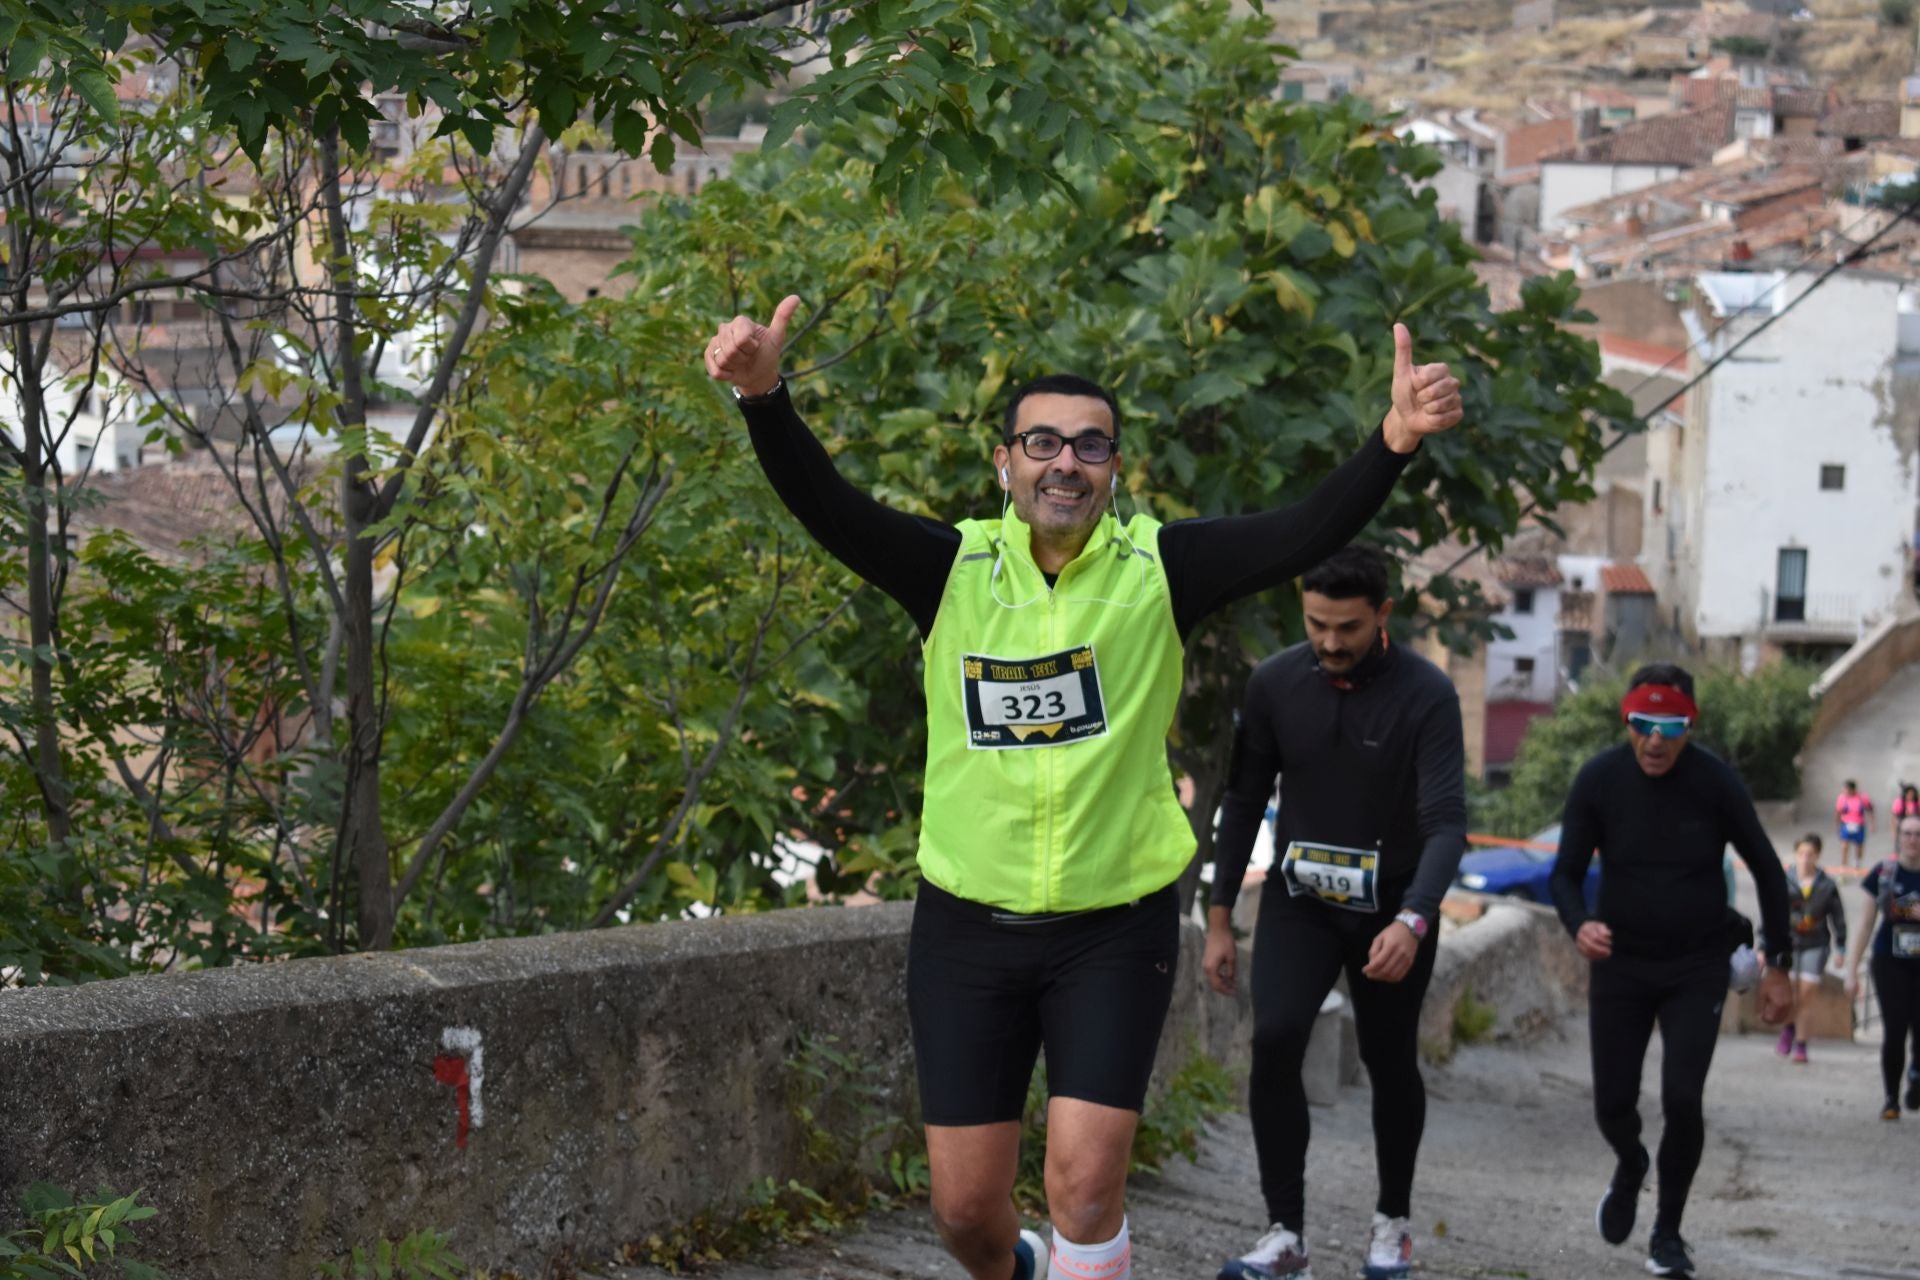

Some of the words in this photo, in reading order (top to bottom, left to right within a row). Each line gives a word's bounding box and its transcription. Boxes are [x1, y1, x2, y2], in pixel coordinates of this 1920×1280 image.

[990, 664, 1028, 680] TRAIL
[1030, 660, 1058, 678] 13K
[1001, 690, 1066, 720] 323
[1309, 872, 1351, 892] 319
